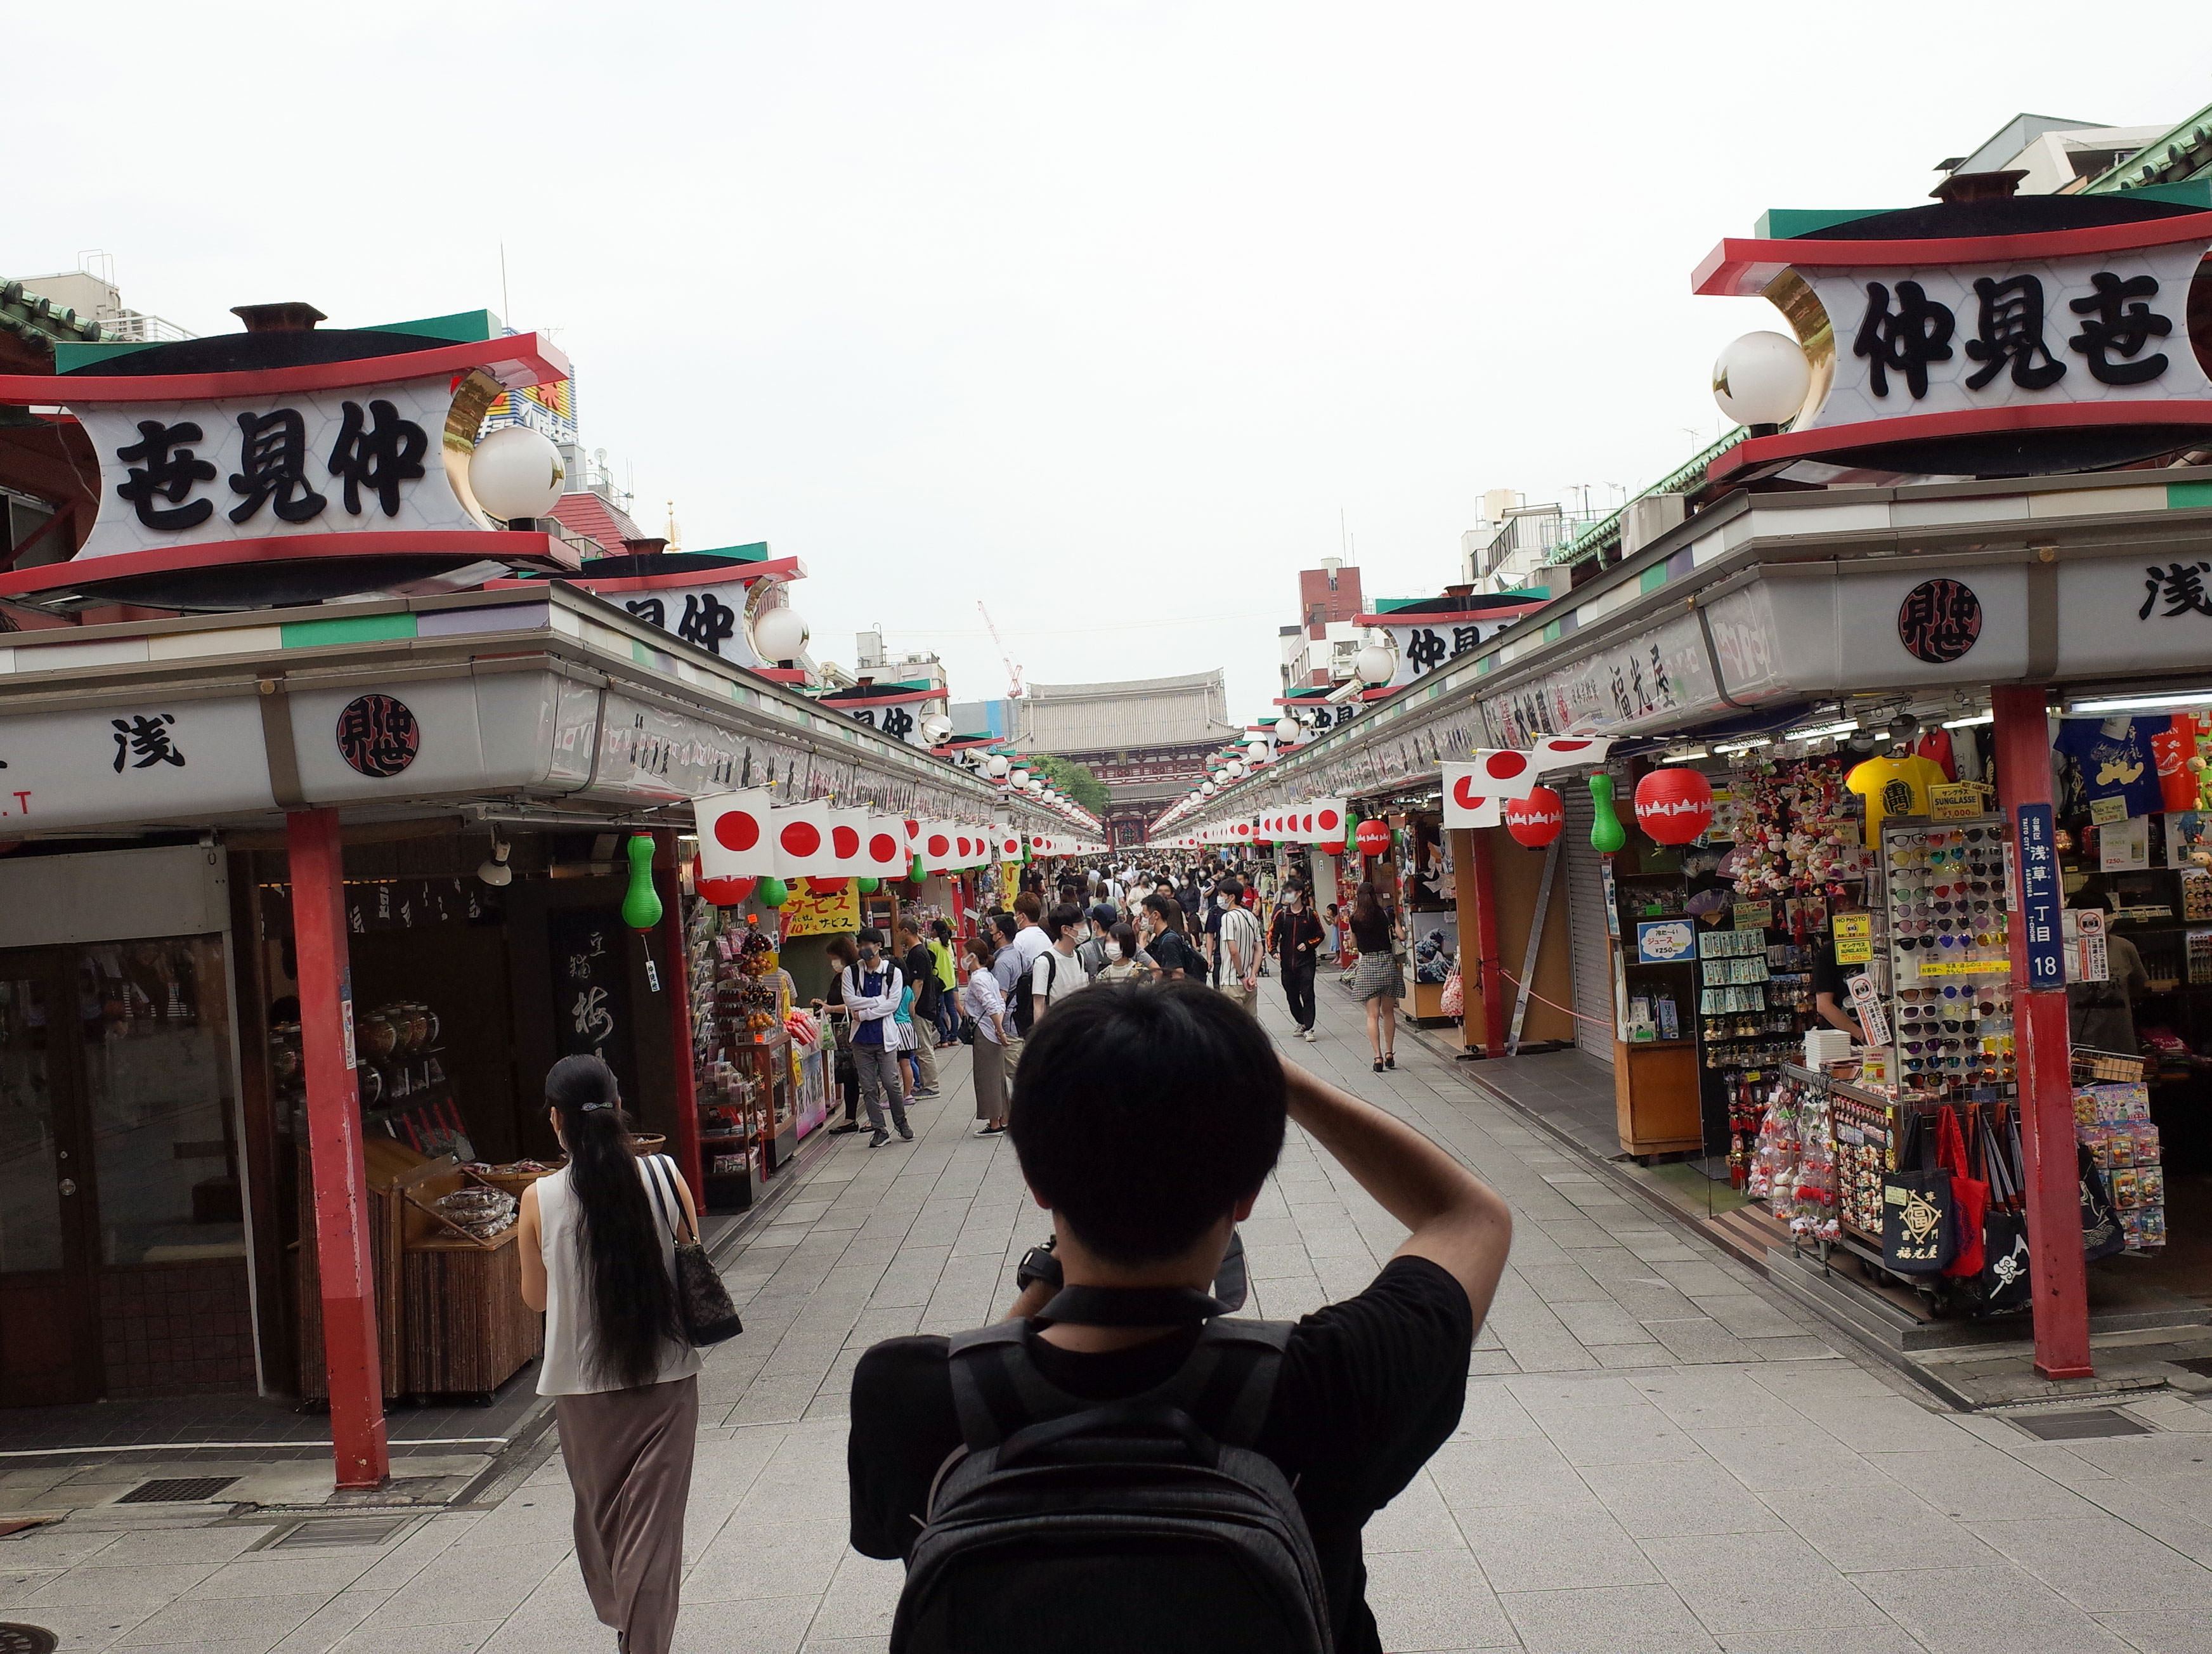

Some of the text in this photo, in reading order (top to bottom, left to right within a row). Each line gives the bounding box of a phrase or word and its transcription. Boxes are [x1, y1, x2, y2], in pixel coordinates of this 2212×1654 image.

[1853, 272, 2171, 400] 仲見世
[112, 714, 185, 773] 浅
[1935, 796, 1976, 805] SUNGLASSE
[2032, 816, 2041, 840] 台東区
[2025, 868, 2033, 898] ASAKUSA
[2030, 845, 2050, 942] 浅草一丁目
[1648, 937, 1673, 945] ジュース
[2034, 956, 2057, 976] 18
[1896, 1244, 1938, 1259] 福光屋
